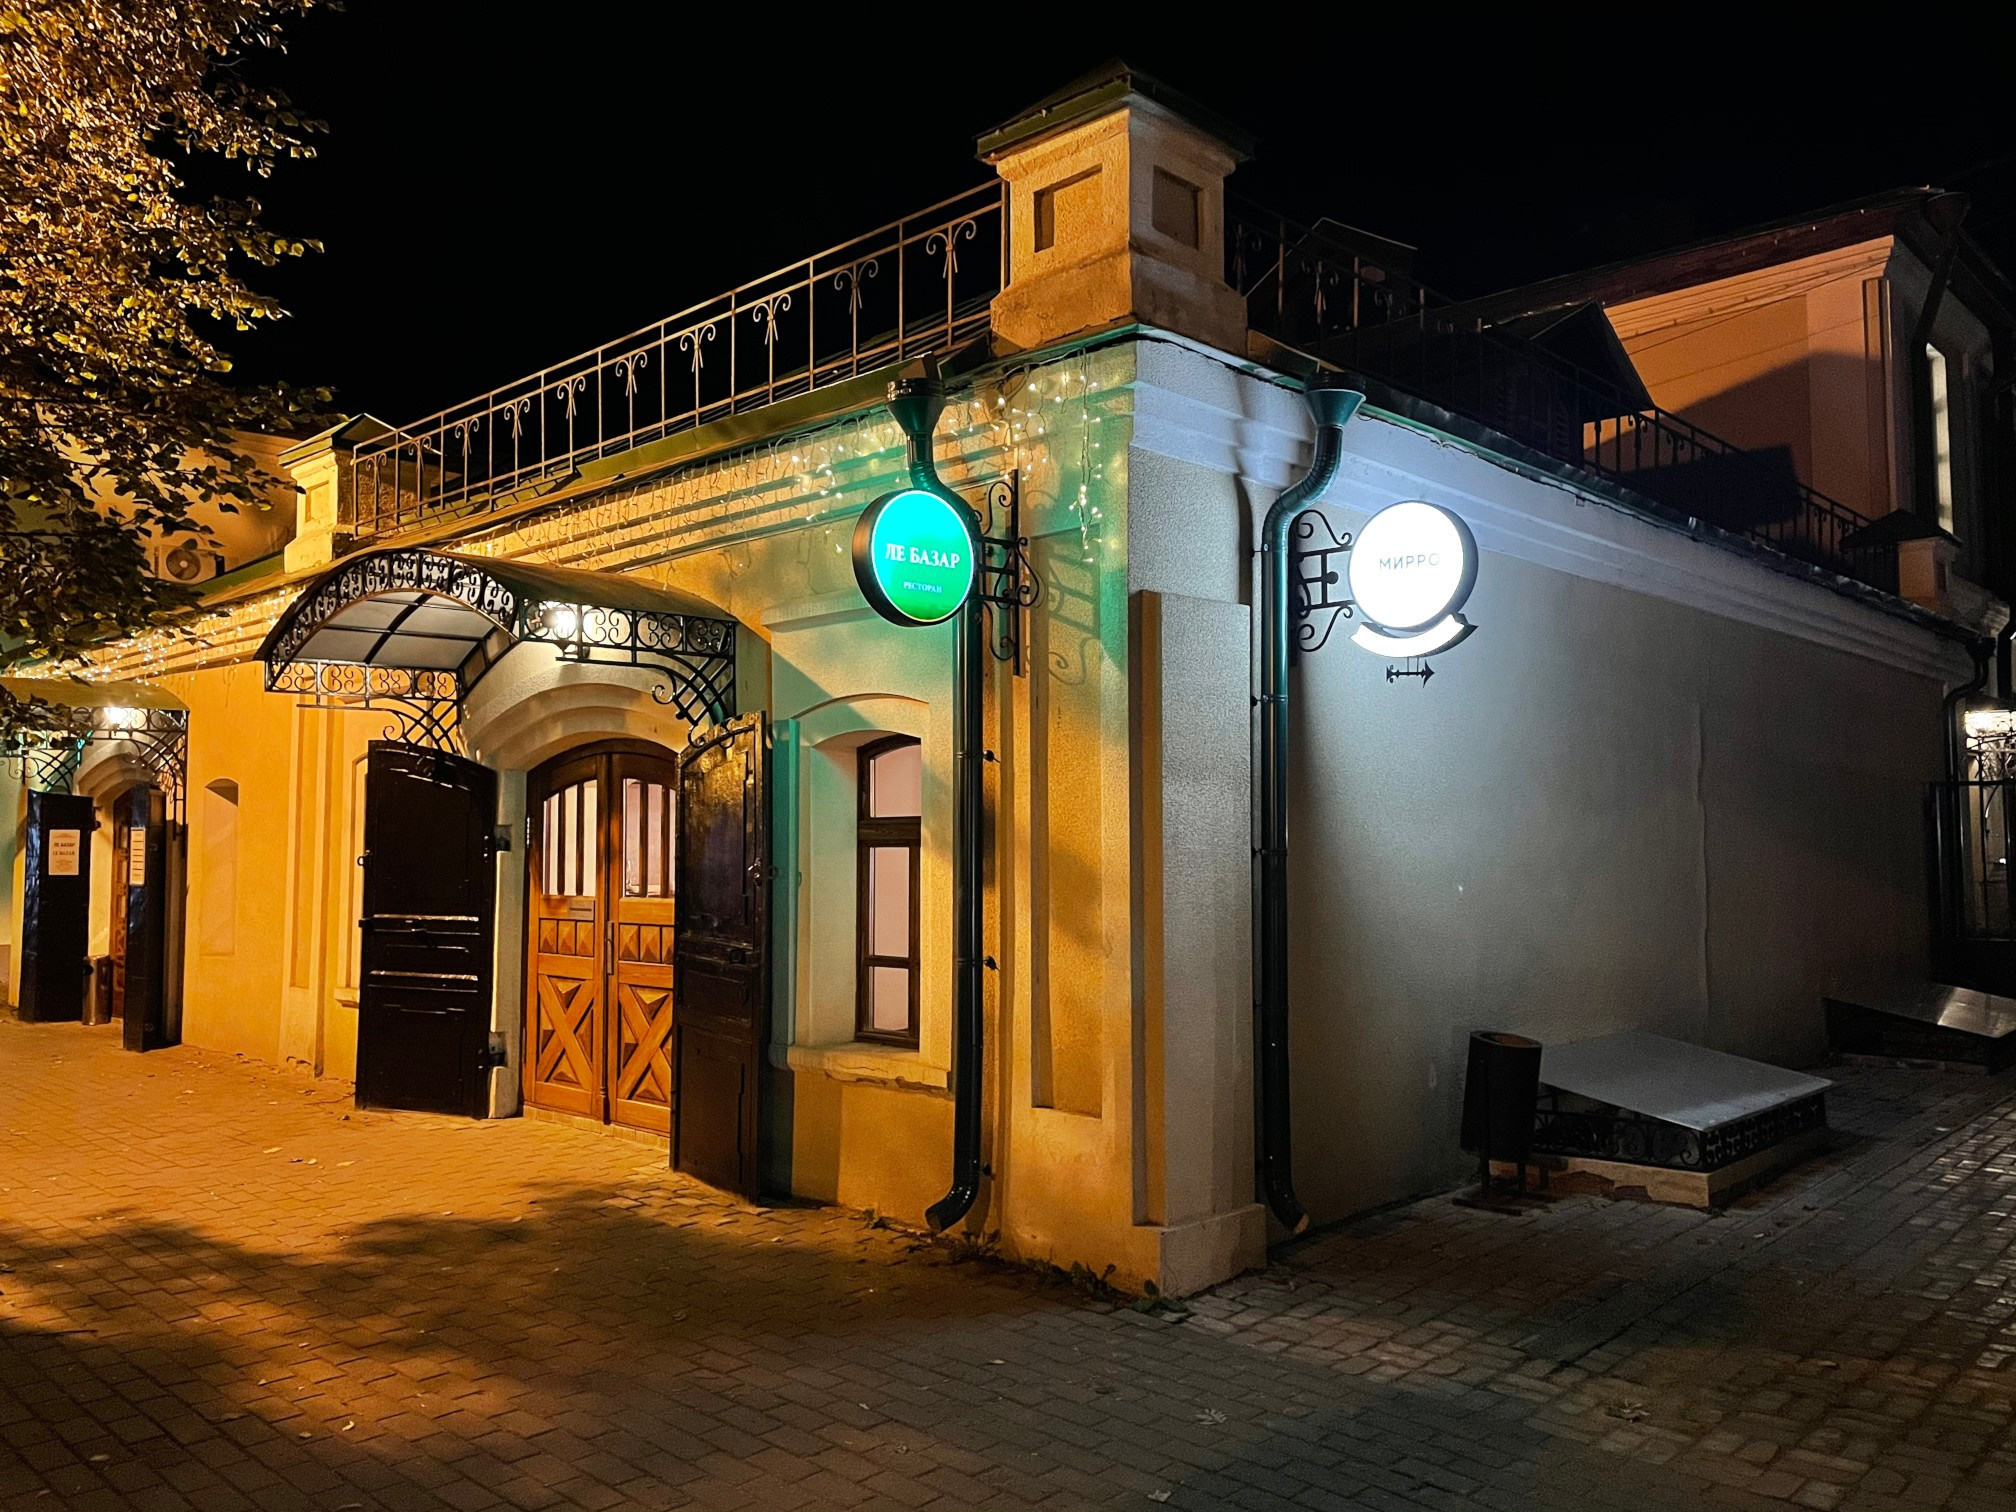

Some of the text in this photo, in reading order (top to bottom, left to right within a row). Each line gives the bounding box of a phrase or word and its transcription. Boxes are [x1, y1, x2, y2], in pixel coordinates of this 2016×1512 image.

[885, 543, 960, 568] ЛЕ БАЗАР
[903, 581, 942, 593] РЕСТОРАН
